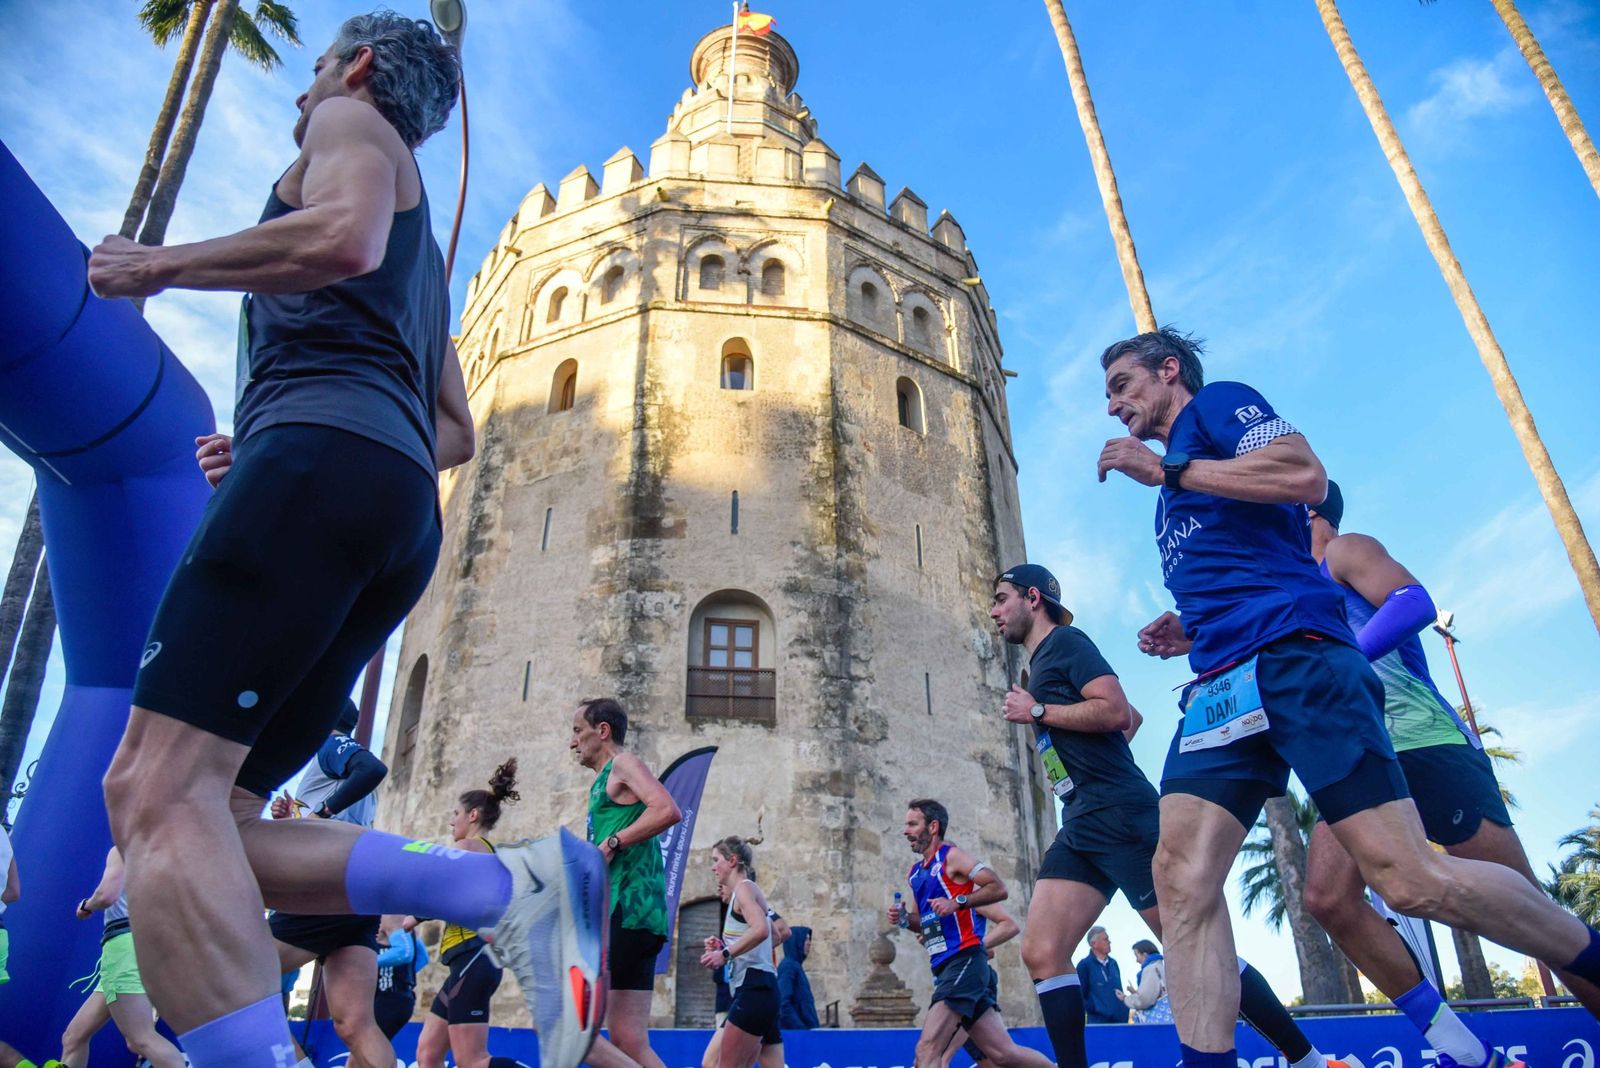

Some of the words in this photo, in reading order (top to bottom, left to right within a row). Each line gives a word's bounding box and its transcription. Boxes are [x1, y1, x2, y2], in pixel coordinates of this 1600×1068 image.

[1207, 678, 1232, 698] 9346
[1205, 694, 1238, 726] DANI
[667, 871, 678, 897] sound
[676, 827, 687, 851] sound
